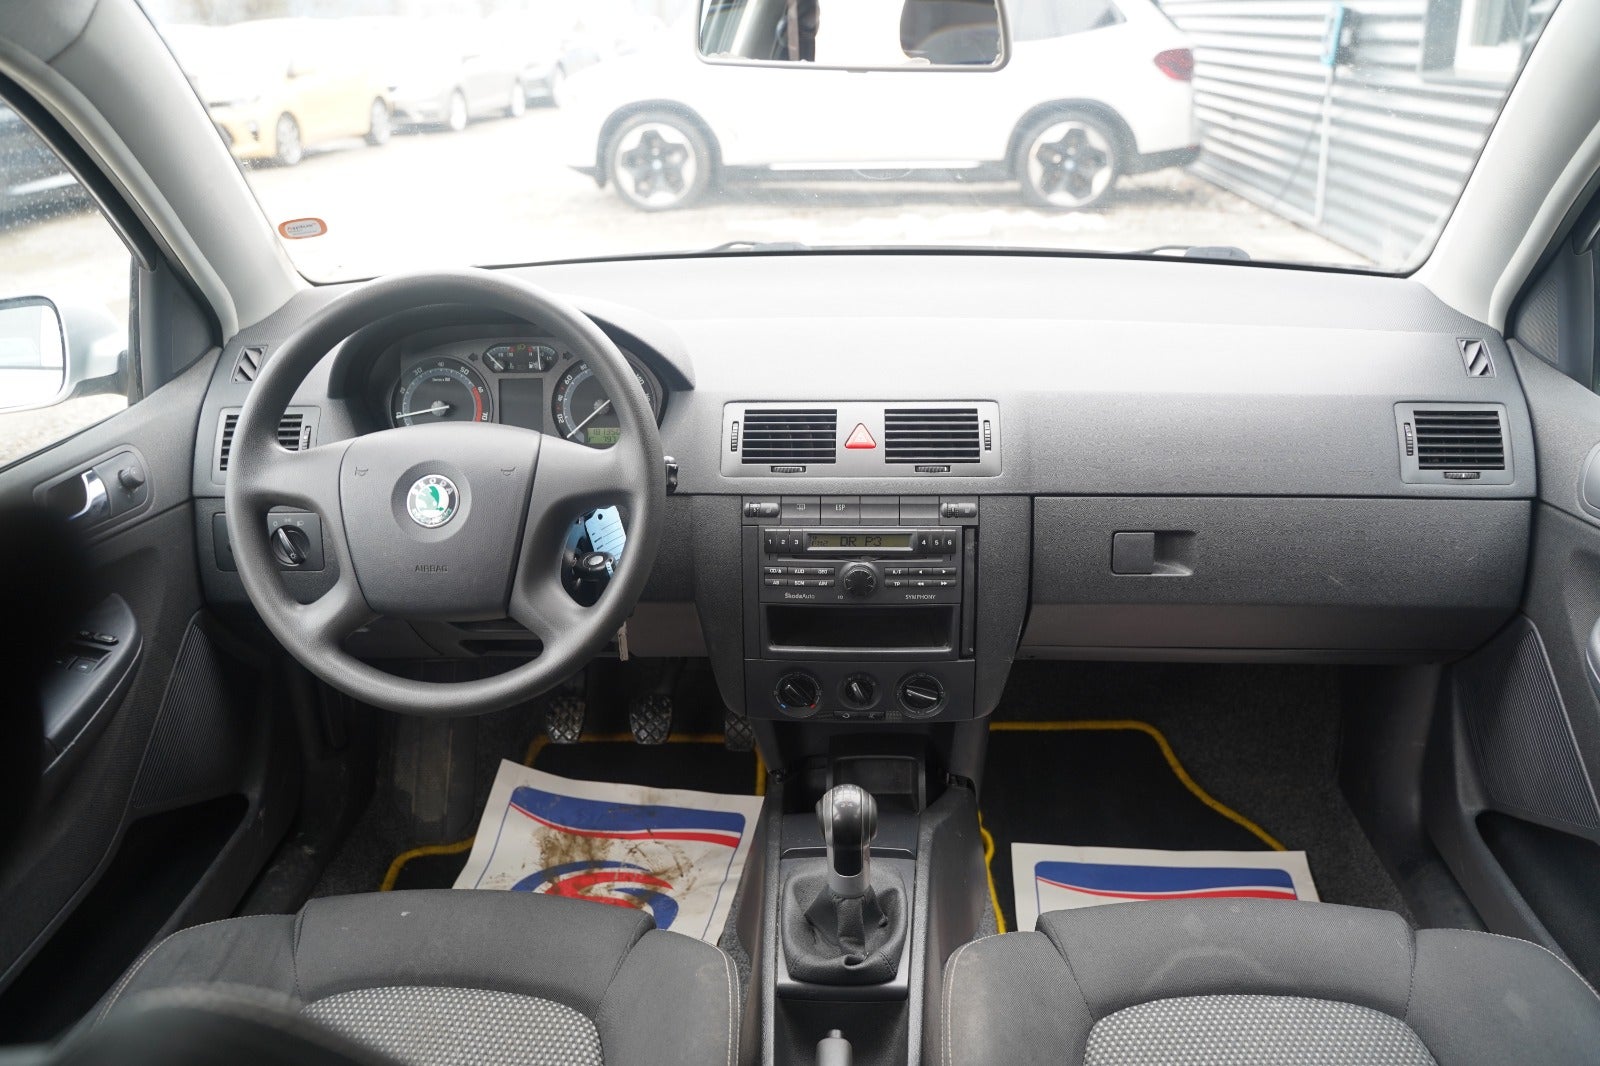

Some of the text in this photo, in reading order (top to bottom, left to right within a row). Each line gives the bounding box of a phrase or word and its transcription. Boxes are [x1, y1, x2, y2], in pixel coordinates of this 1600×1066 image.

[459, 366, 470, 375] 50
[564, 374, 574, 385] 60
[840, 536, 882, 547] DR P3
[414, 564, 448, 573] AIRBAG
